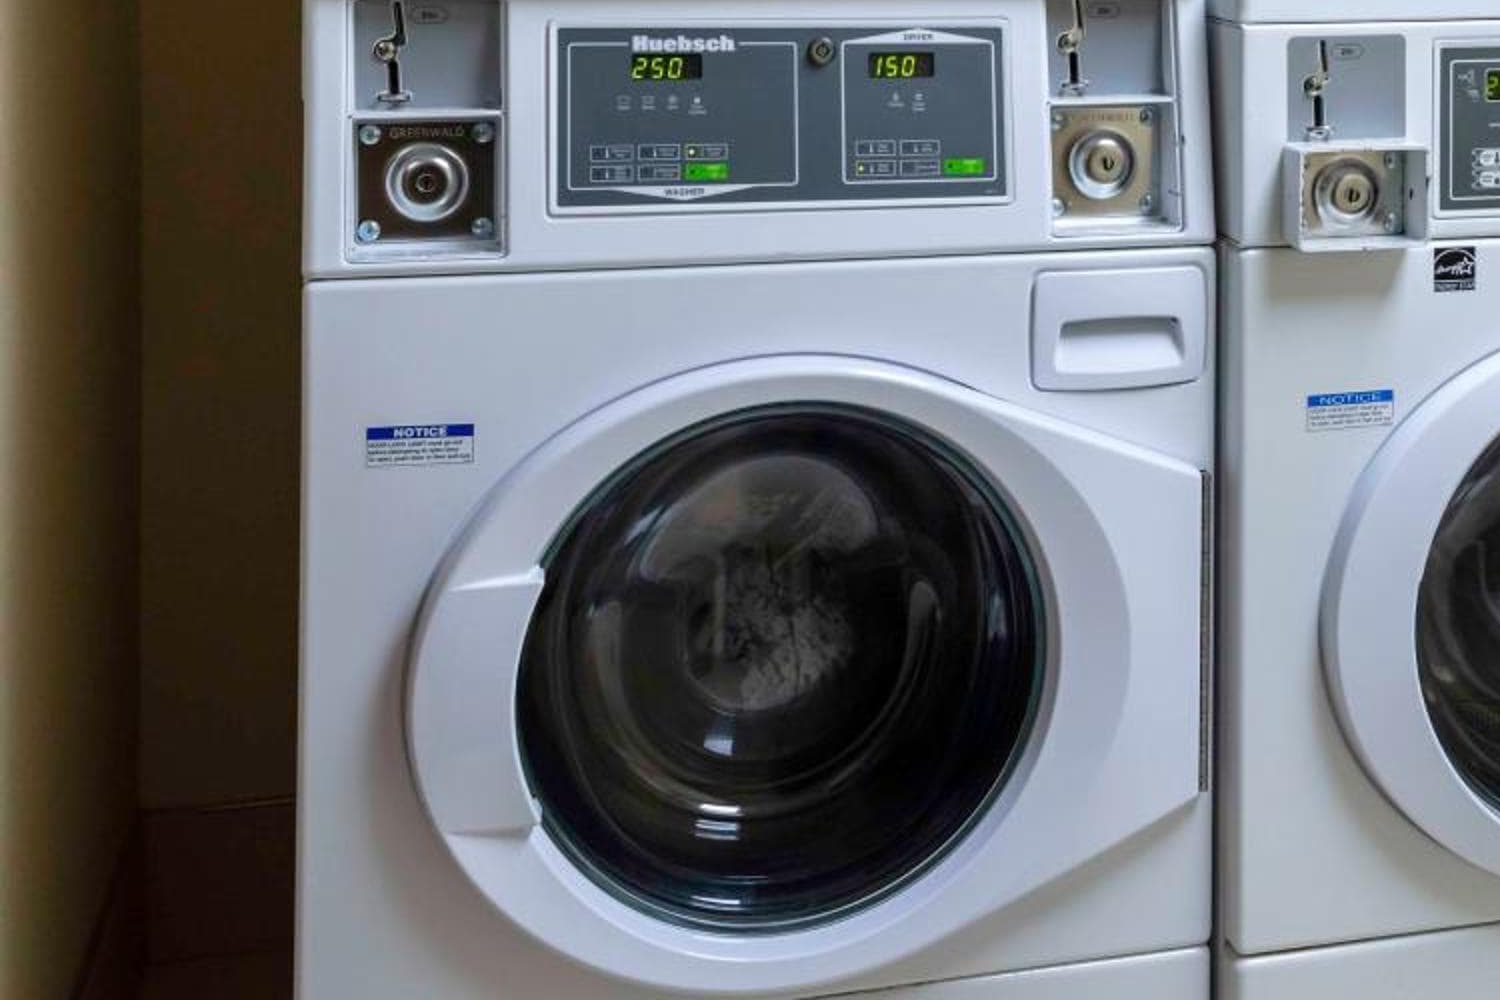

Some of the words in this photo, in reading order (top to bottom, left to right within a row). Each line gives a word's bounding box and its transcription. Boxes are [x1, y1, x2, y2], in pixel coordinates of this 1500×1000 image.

[631, 34, 736, 52] Huebsch
[631, 56, 684, 79] 250
[875, 55, 916, 77] 150
[388, 126, 465, 139] GREENWALD
[663, 187, 705, 196] WASHER
[1319, 394, 1379, 405] NOTICE
[393, 426, 447, 438] NOTICE
